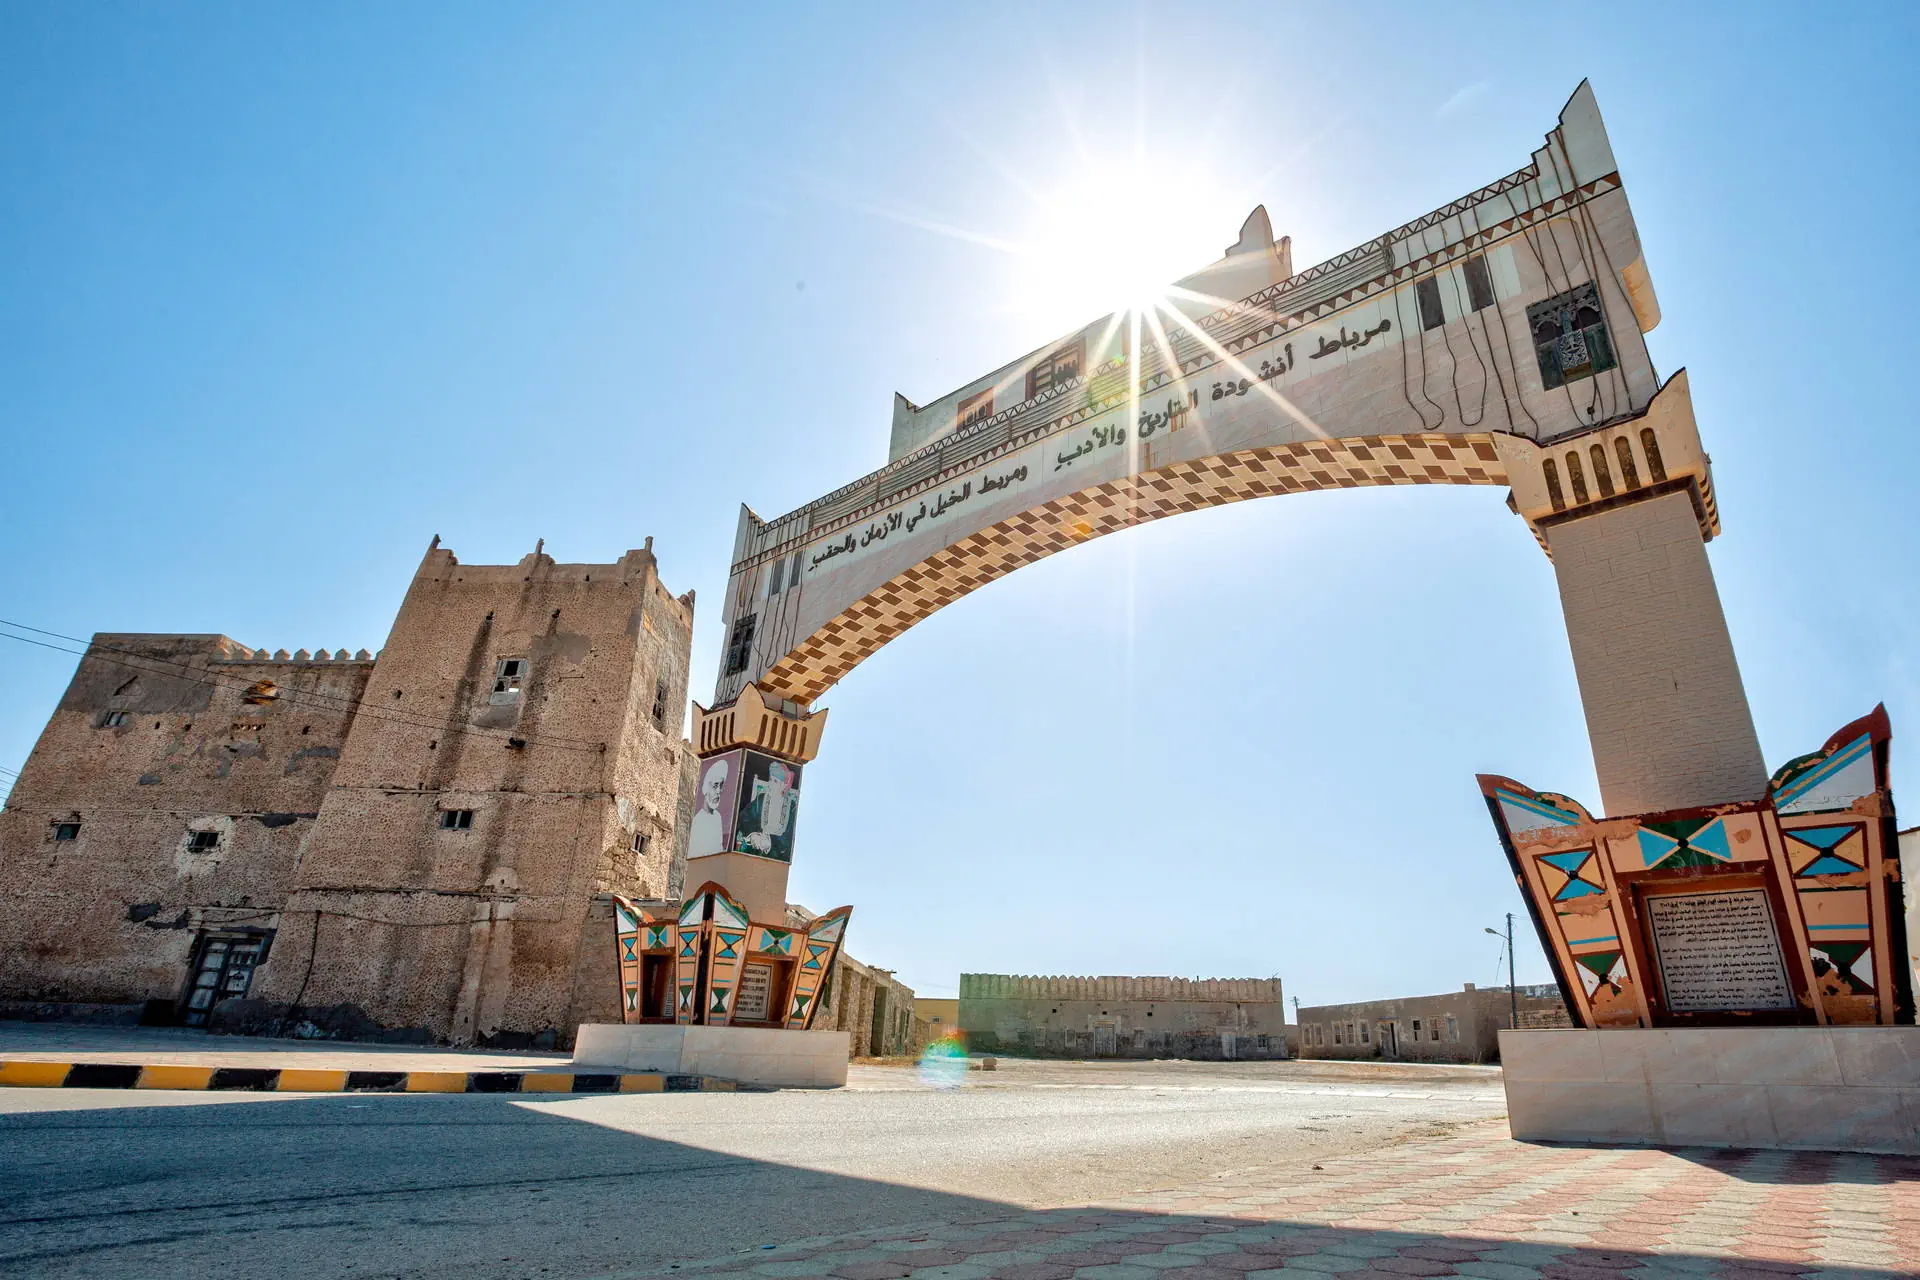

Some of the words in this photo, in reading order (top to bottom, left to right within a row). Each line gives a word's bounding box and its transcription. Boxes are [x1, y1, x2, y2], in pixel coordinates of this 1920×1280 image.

[1309, 319, 1391, 360] مرباط
[1211, 342, 1294, 401] أنشودة
[976, 463, 1028, 495] ومربط
[905, 501, 926, 533] في
[930, 481, 971, 518] الخيل
[860, 511, 903, 547] الأزمان
